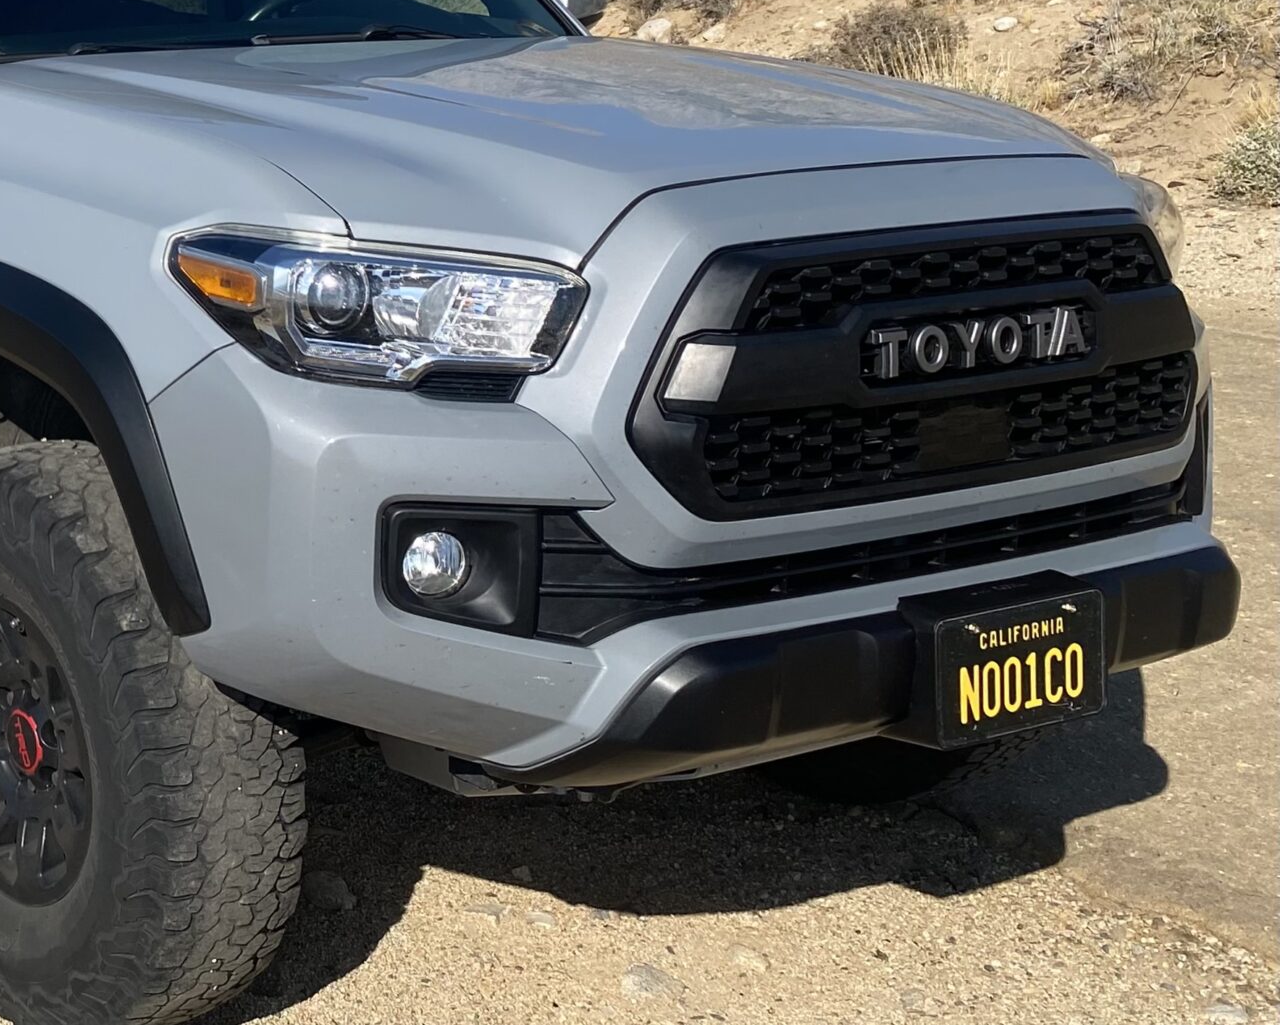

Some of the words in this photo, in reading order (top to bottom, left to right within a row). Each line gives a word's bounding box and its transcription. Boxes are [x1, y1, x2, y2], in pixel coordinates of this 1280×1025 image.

[872, 306, 1088, 379] TOYOTA
[979, 616, 1064, 650] CALIFORNIA
[15, 716, 31, 767] TRD
